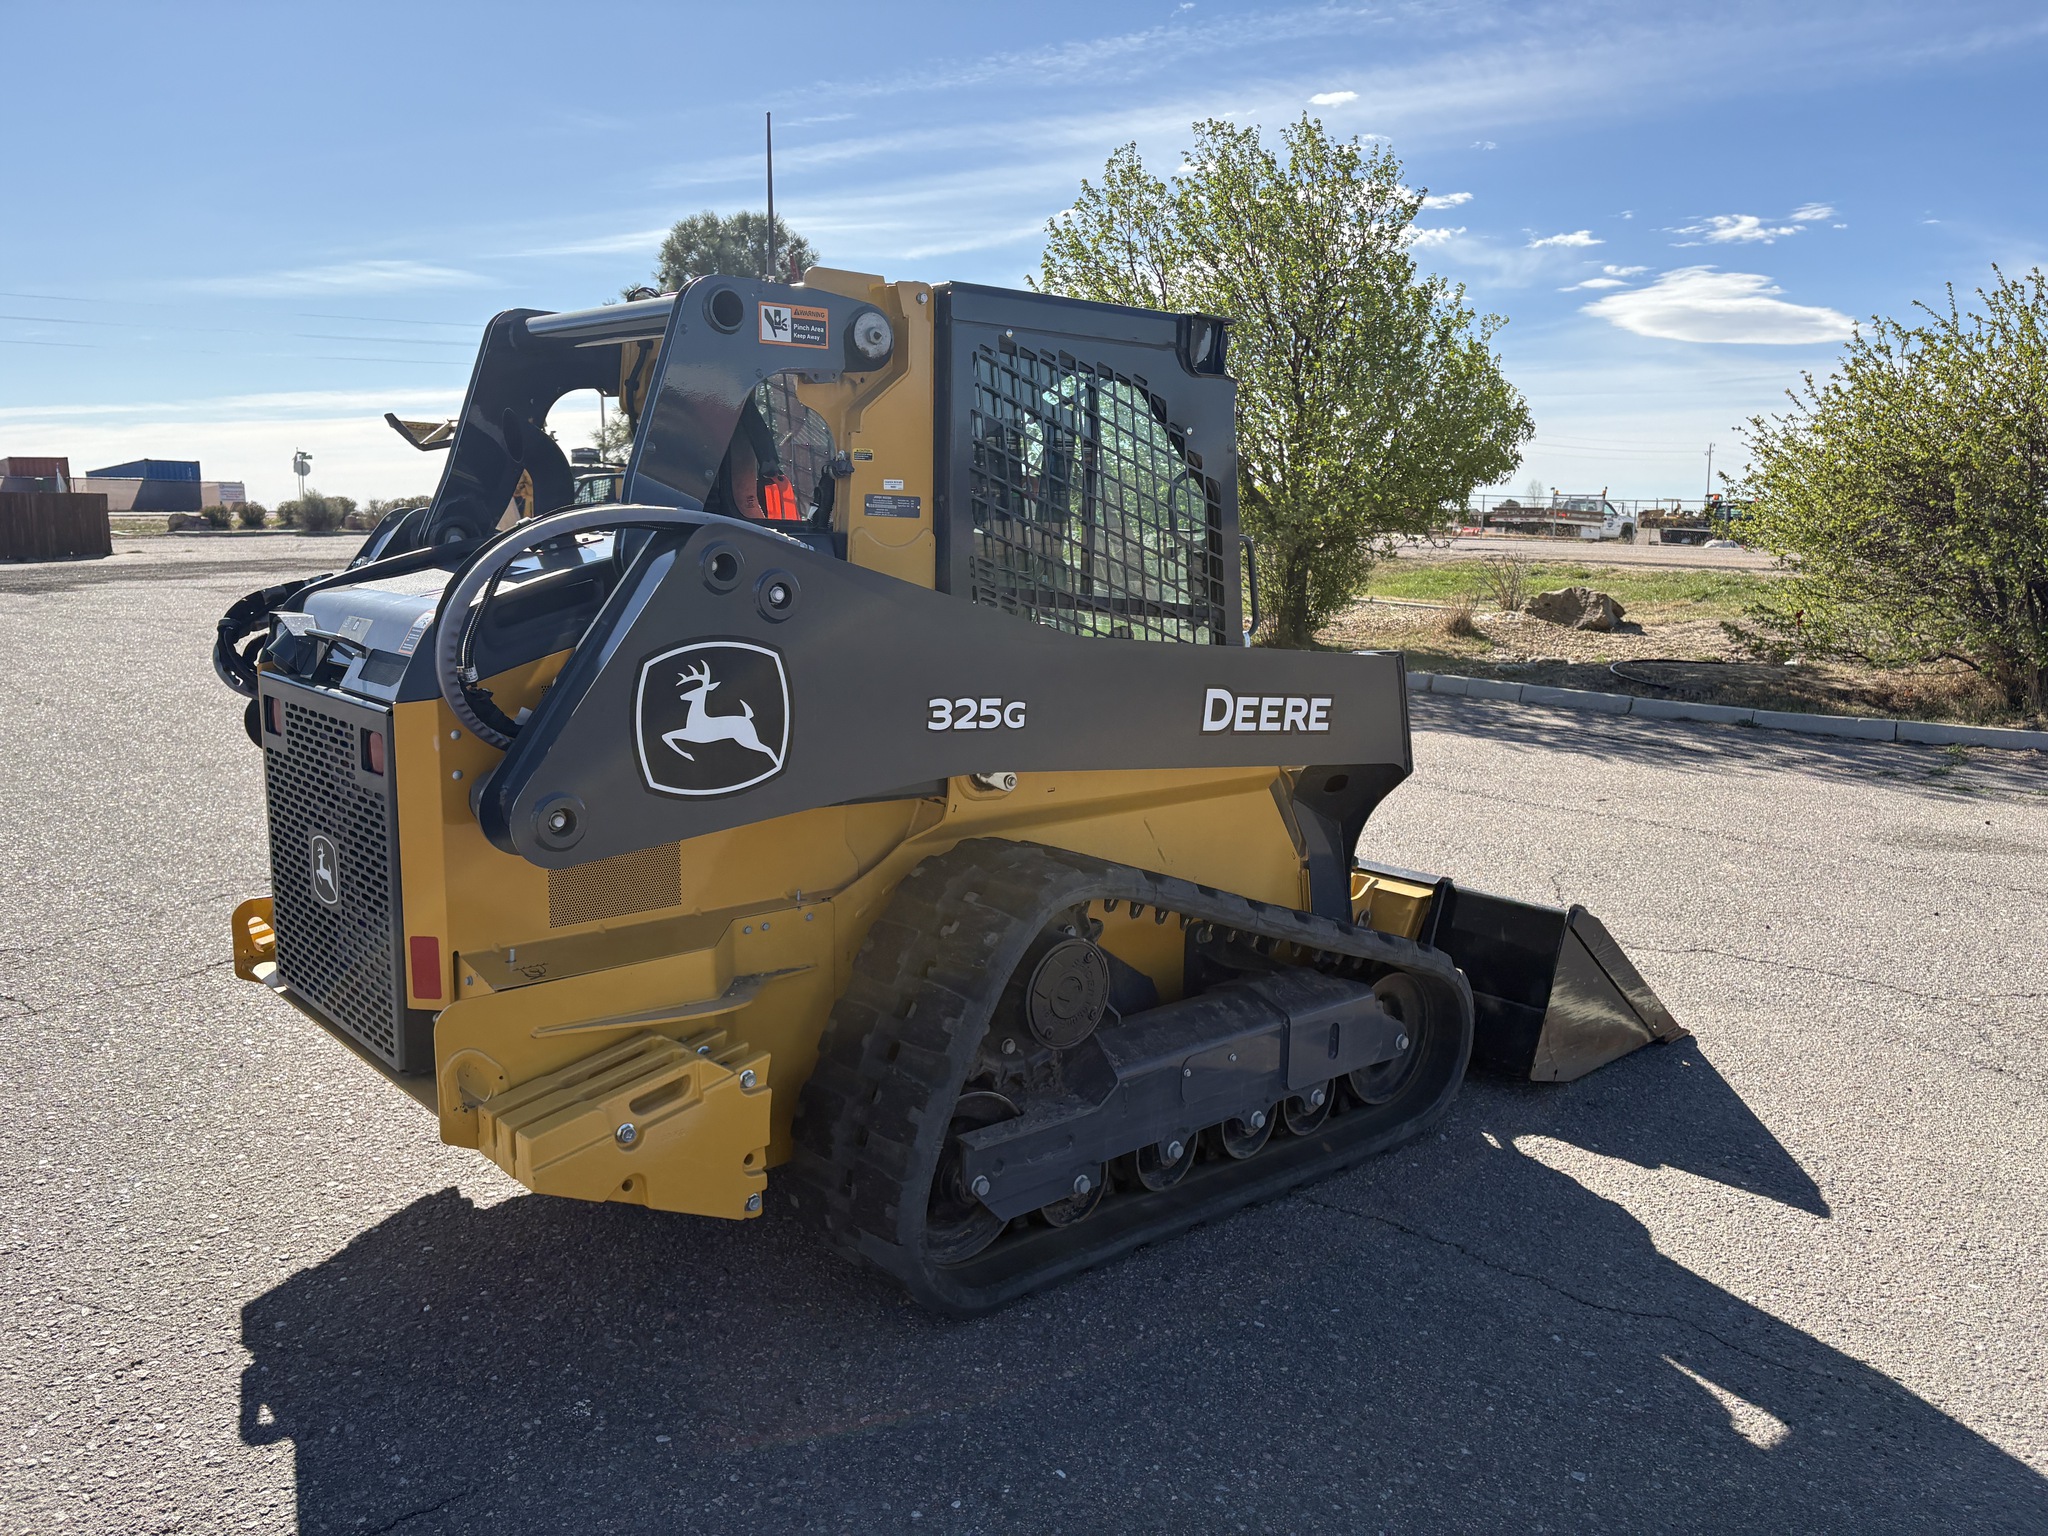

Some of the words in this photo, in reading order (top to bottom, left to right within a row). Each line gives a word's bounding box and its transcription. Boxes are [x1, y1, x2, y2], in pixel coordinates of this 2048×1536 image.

[799, 310, 825, 318] WARNING
[793, 323, 810, 331] Pinch
[811, 325, 824, 333] Area
[793, 332, 806, 340] Keep
[927, 698, 1026, 731] 325G
[1202, 688, 1332, 732] DEERE
